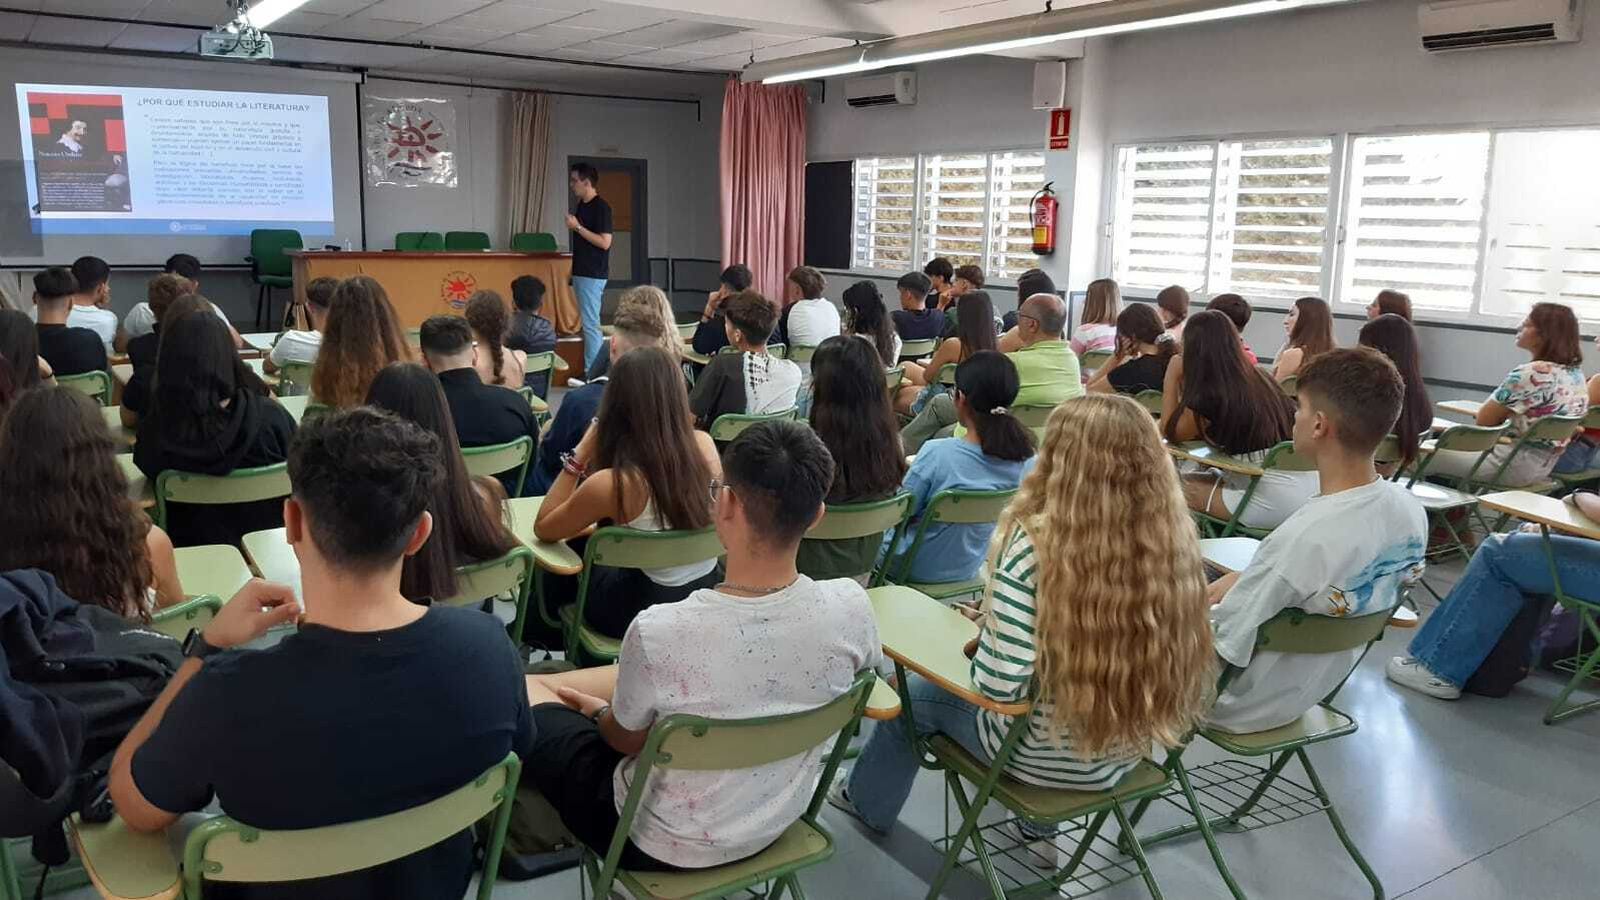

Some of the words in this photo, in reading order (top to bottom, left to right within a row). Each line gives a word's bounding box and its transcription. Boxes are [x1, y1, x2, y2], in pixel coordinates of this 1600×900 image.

[187, 99, 233, 108] ESTUDIAR
[236, 101, 247, 109] LA
[250, 102, 310, 112] LITERATURA?
